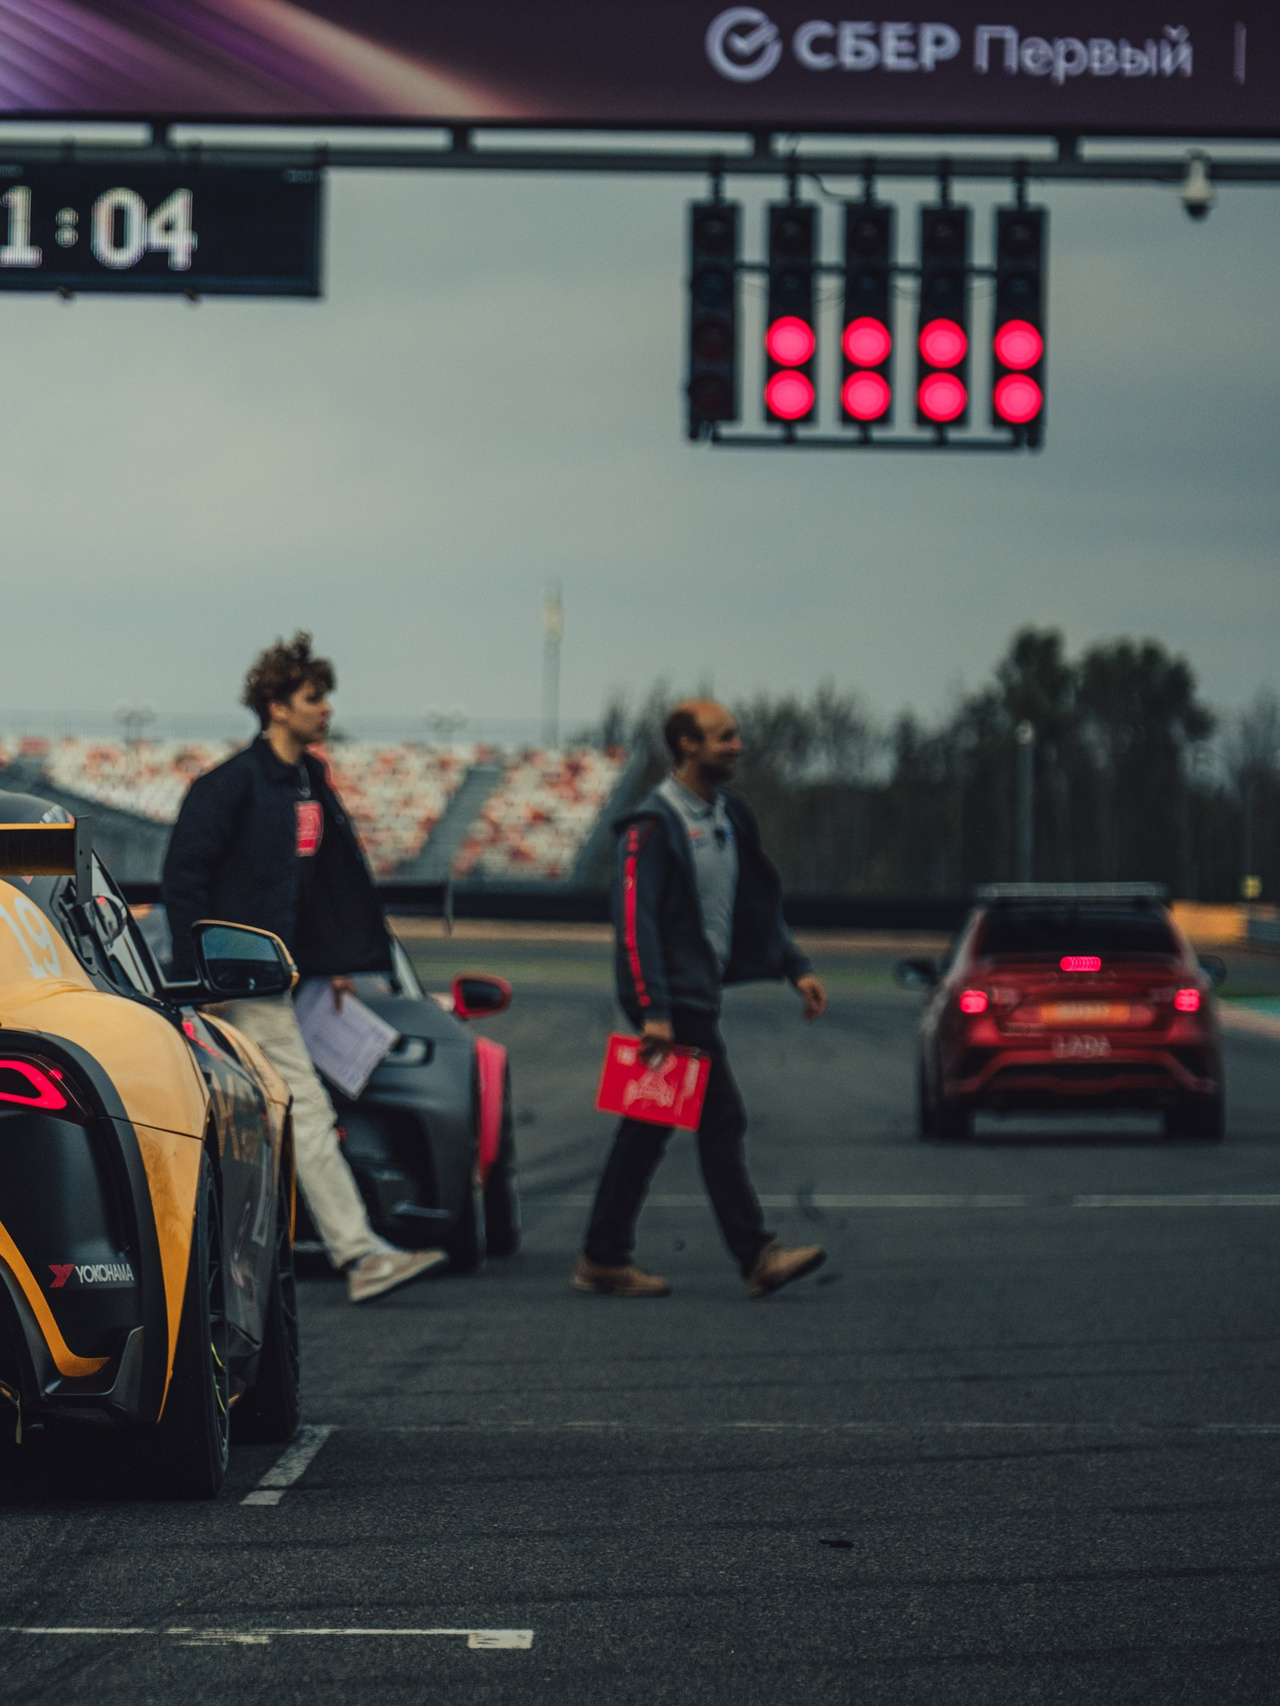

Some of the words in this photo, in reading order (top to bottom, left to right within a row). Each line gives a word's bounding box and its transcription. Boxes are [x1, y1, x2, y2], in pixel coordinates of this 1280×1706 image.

[793, 20, 961, 72] СБЕР
[973, 24, 1193, 86] Первый
[75, 1263, 134, 1284] YOKOHAMA
